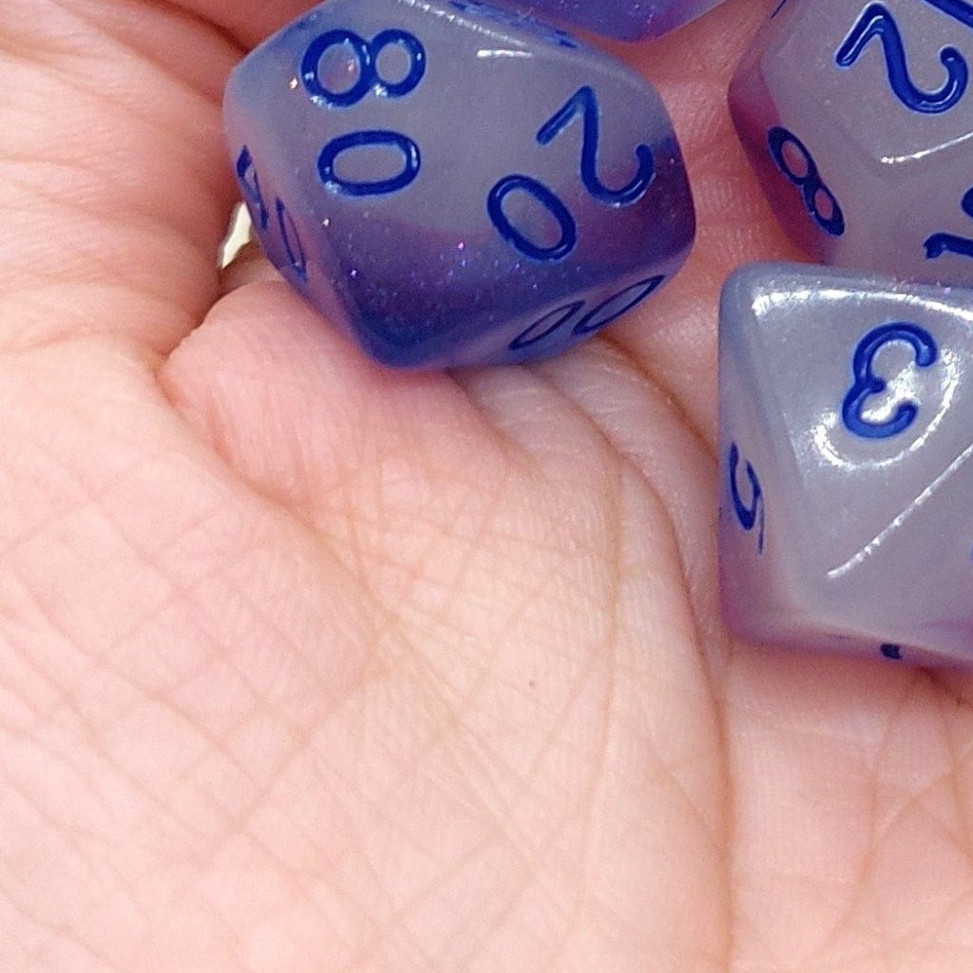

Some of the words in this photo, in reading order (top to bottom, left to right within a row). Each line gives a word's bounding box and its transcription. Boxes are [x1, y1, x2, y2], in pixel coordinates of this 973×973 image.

[301, 28, 427, 198] 80
[487, 85, 655, 262] 20
[767, 126, 846, 237] 8
[841, 321, 939, 441] 3
